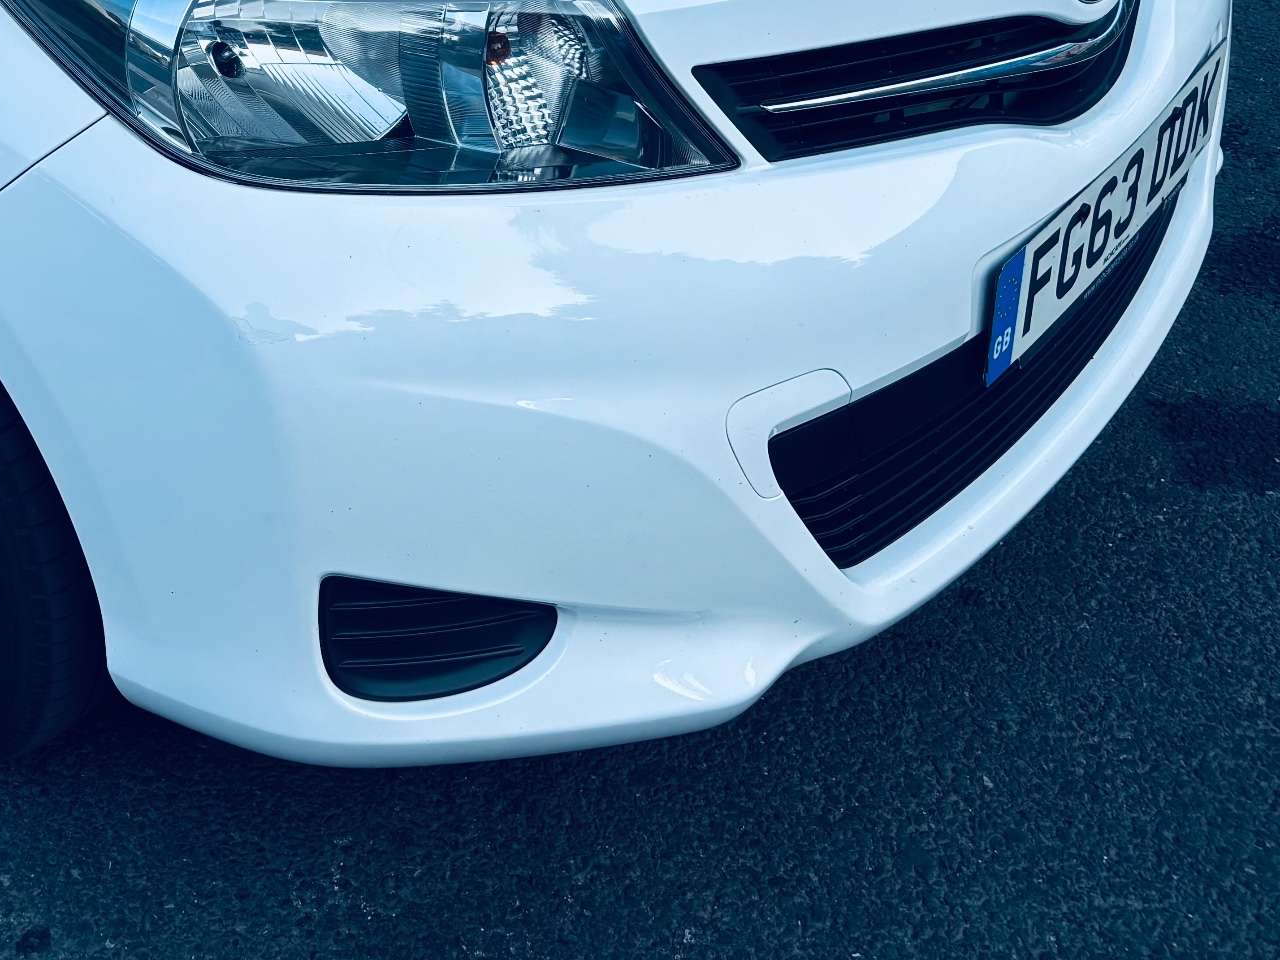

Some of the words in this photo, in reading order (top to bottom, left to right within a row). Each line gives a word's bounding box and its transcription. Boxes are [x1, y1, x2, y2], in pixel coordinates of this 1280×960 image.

[1022, 147, 1145, 338] FG63
[1146, 57, 1221, 208] DDK
[992, 325, 1012, 360] GB
